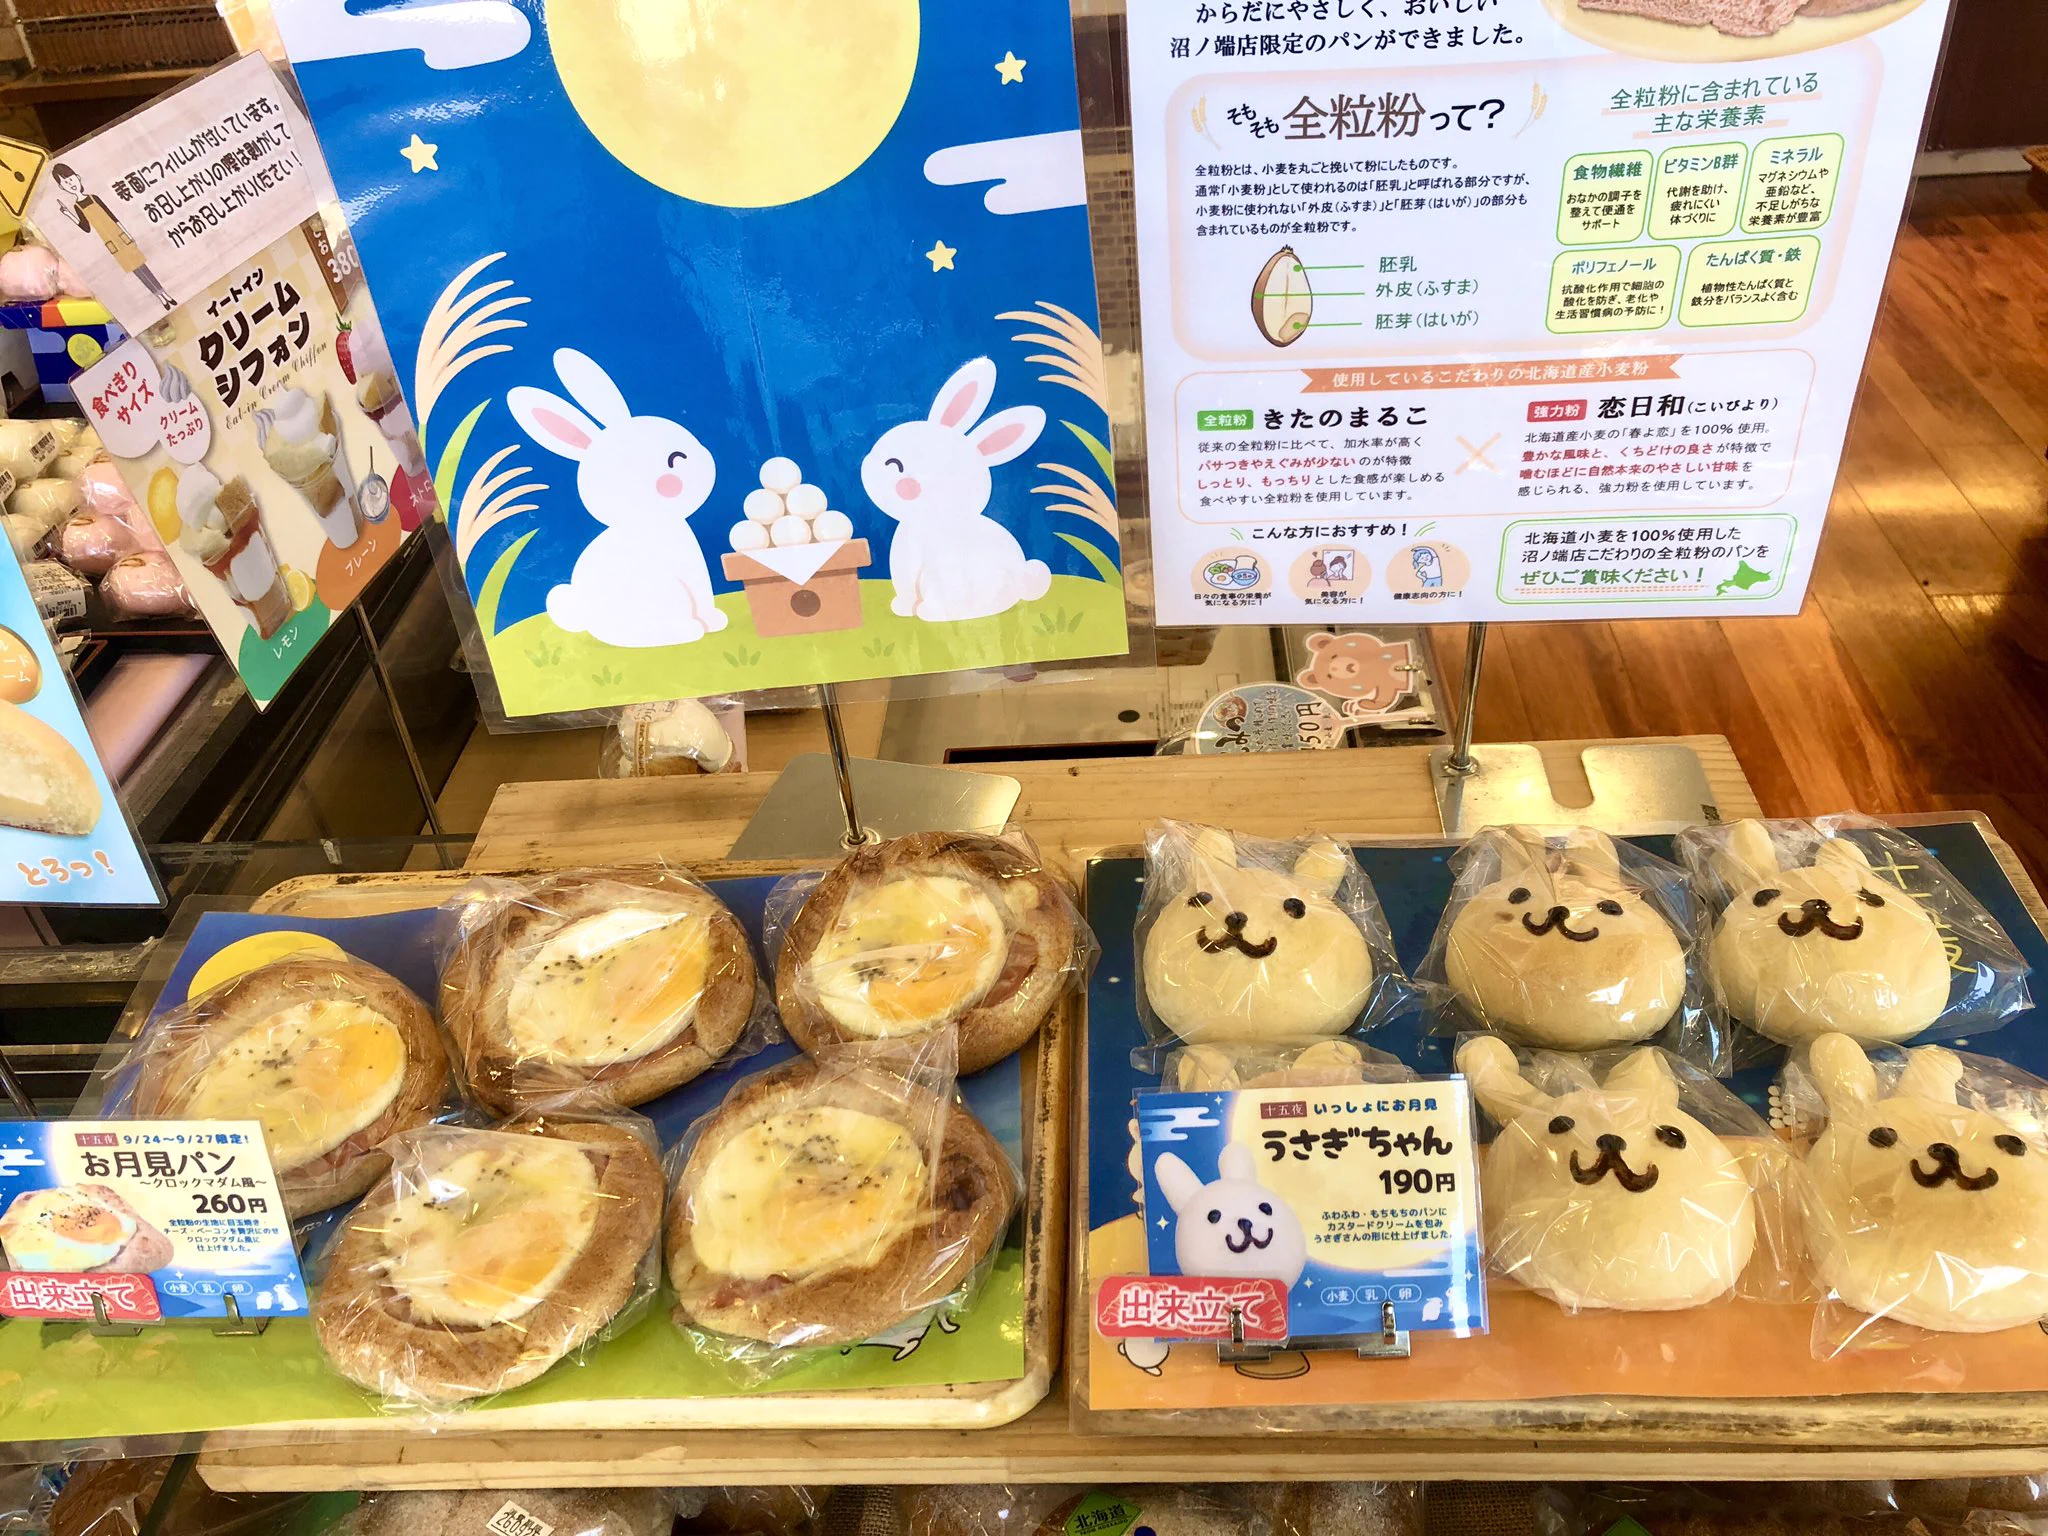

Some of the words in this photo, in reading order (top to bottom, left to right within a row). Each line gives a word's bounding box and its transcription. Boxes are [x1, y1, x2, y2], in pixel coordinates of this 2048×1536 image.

[1170, 23, 1526, 58] 沼ノ端店限定のパンができました。
[1610, 72, 1819, 111] 全粒粉に含まれている
[1651, 104, 1767, 134] 主な栄養素
[111, 97, 281, 201] 表面にフィルムが付いています。
[1769, 147, 1824, 165] ミネラル
[1195, 157, 1458, 178] 全粒粉とは、小麦を丸ごと挽いて粉にしたものです。
[1573, 162, 1643, 181] 食物繊維
[1758, 168, 1829, 183] マグネシウムや
[1195, 174, 1530, 197] 通常「小麦粉」として使われるのは「胚乳」と呼ばれる部分ですが、
[1666, 184, 1729, 199] 代謝を助け、
[1765, 184, 1815, 198] 亜鉛など、
[1566, 189, 1642, 205] おなかの調子を
[1670, 198, 1720, 211] 疲れにくい
[1755, 197, 1820, 212] 不足しがちな
[1569, 203, 1635, 219] 整えて便通を
[1669, 212, 1716, 226] 体づくりに
[1748, 210, 1821, 227] 栄養素が豊富
[1197, 219, 1357, 237] 含まれているものが全粒粉です。
[1581, 218, 1620, 231] サポート
[1379, 256, 1417, 274] 胚乳
[1571, 257, 1656, 275] ポリフェノール
[1706, 248, 1802, 267] たんぱく質・鉄
[207, 267, 265, 318] イートイン
[1561, 280, 1665, 295] 抗酸化作用で細胞の
[1701, 279, 1794, 294] 植物性たんぱく質と
[1563, 293, 1660, 308] 酸化を防ぎ、老化や
[1691, 291, 1799, 308] 鉄分をバランスよく含む
[199, 279, 301, 371] クリーム
[215, 311, 311, 408] シフォン
[292, 342, 327, 372] Chiffon
[1332, 362, 1649, 387] 使用しているこだわりの北海道産小麦粉
[91, 360, 138, 421] 食べきり
[117, 384, 155, 425] サイズ
[1533, 404, 1581, 418] 強力粉
[159, 402, 199, 427] クリーム
[1204, 414, 1248, 428] 全粒粉
[1264, 406, 1428, 430] きたのまるこ
[166, 417, 204, 448] たっぷり
[1198, 436, 1423, 454] 従来の全粒粉に比べて、加水率が高く
[1198, 471, 1446, 490] しっとり、もっちりとした食感が楽しめる
[1517, 480, 1755, 497] 感じられる、強力粉を使用しています。
[1199, 489, 1414, 508] 食べやすい全粒粉を使用しています。
[1252, 524, 1409, 540] こんな方におすすめ！
[344, 538, 378, 577] プレーン
[1521, 544, 1769, 564] 沼ノ端店こだわりの全粒粉のパンを
[1520, 567, 1706, 586] ぜひご賞味ください！
[1194, 592, 1272, 600] 日々の食事の栄養が
[1320, 591, 1347, 599] 美容が
[272, 626, 299, 660] レモン
[1264, 1104, 1304, 1117] 十五夜
[1313, 1099, 1438, 1114] いっしょにお月見
[1262, 1125, 1454, 1161] うさぎちゃん
[81, 1151, 236, 1178] お月見パン
[1379, 1169, 1456, 1194] 190円
[192, 1194, 268, 1214] 260円
[1327, 1218, 1444, 1232] カスタードクリームを包み
[10, 1279, 138, 1311] 出来立て
[1326, 1290, 1350, 1304] 小麦
[1365, 1288, 1379, 1301] 乳
[1399, 1287, 1414, 1301] 卵
[1120, 1285, 1265, 1327] 出来立て
[1075, 1503, 1126, 1530] 北海道
